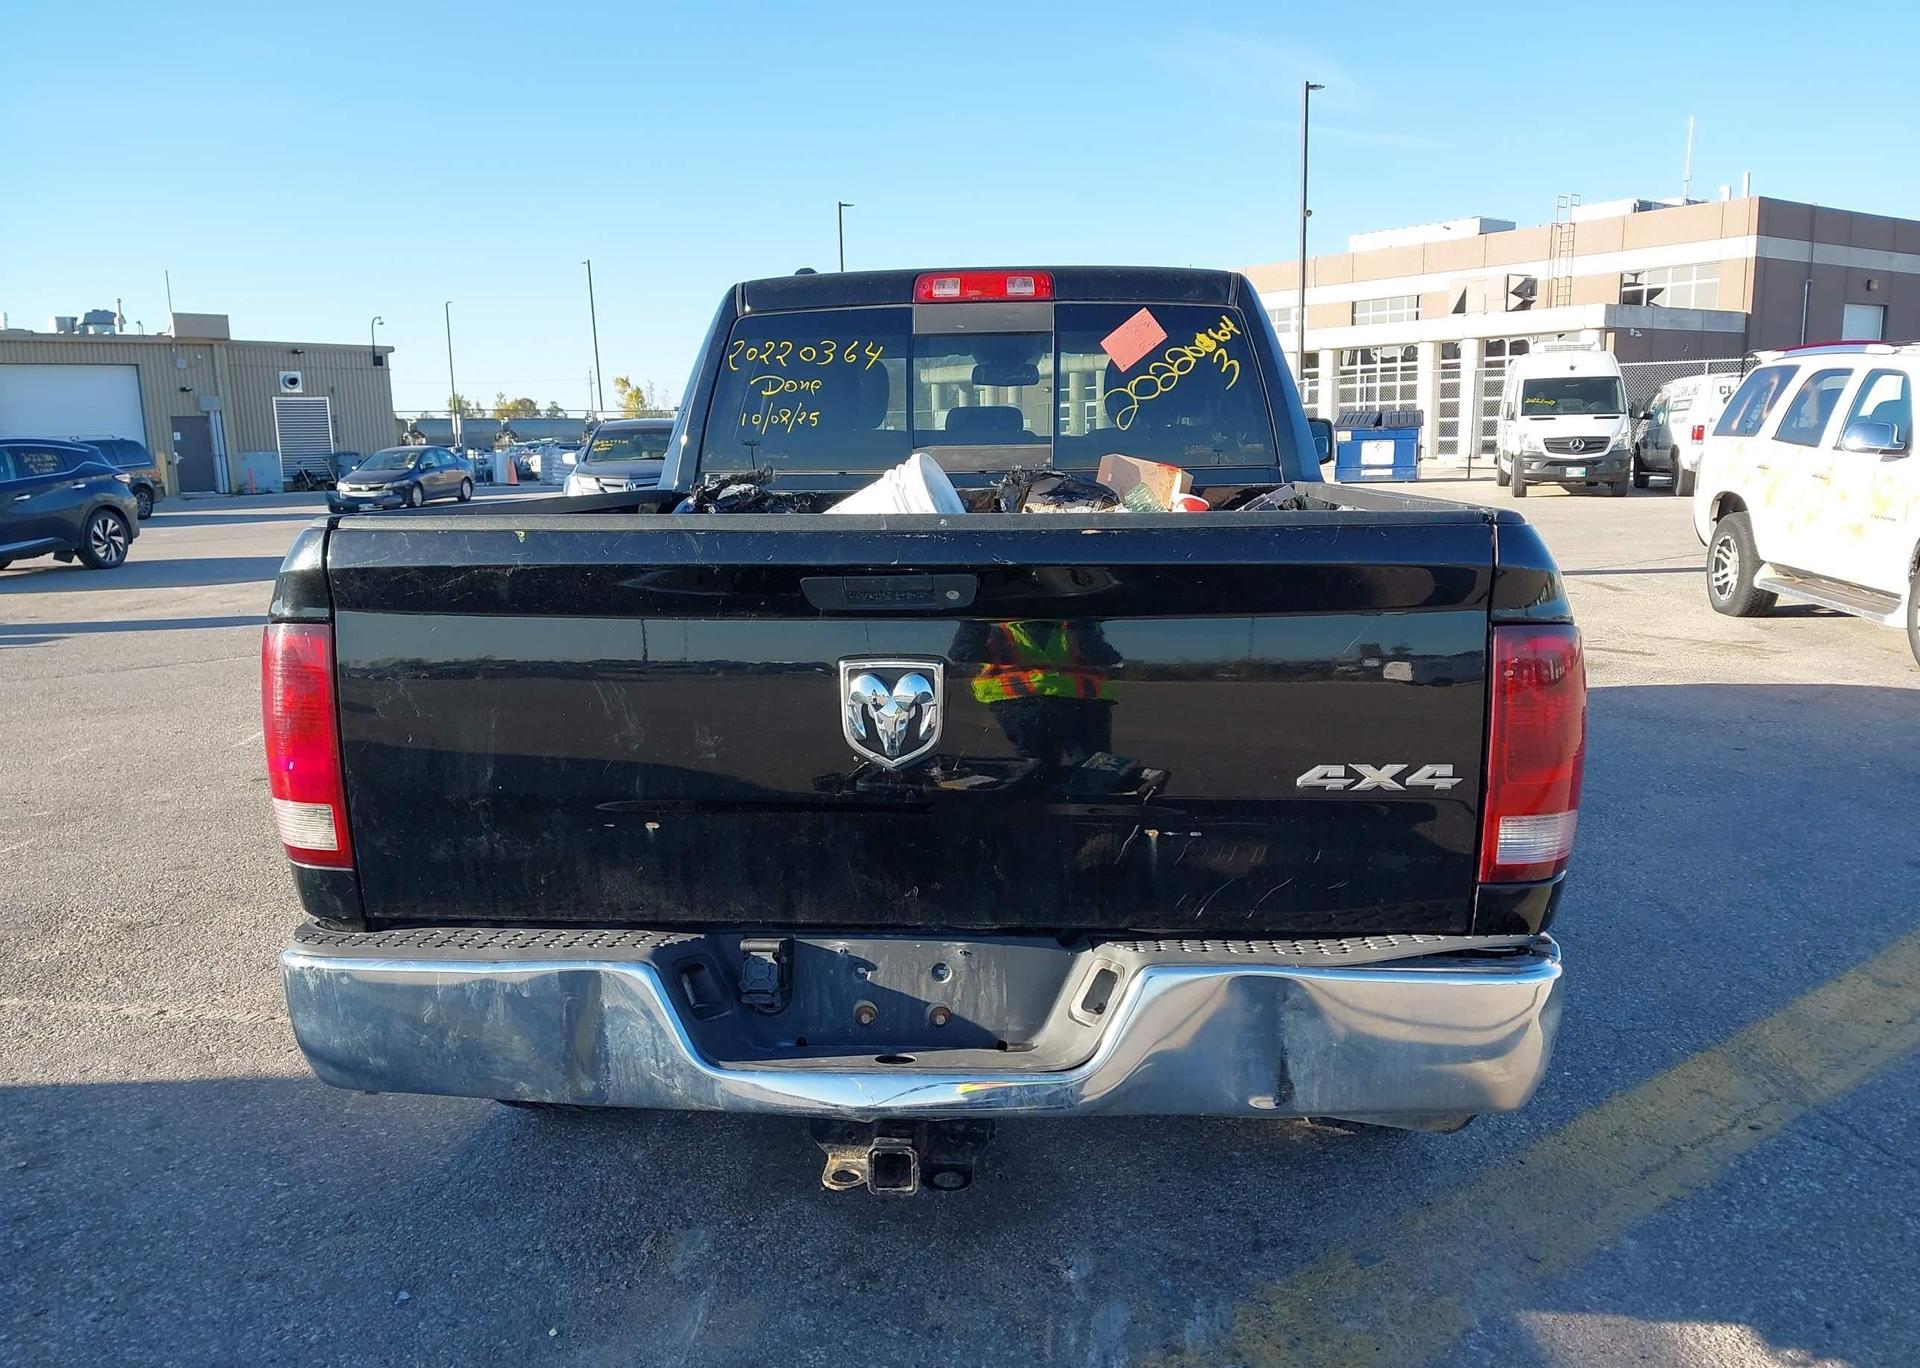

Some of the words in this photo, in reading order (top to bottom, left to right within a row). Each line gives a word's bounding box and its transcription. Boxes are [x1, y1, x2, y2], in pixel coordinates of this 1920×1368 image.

[728, 340, 884, 371] 20220364
[750, 375, 822, 396] Done
[741, 402, 820, 435] 10/08/25
[1296, 763, 1464, 791] 4X4
